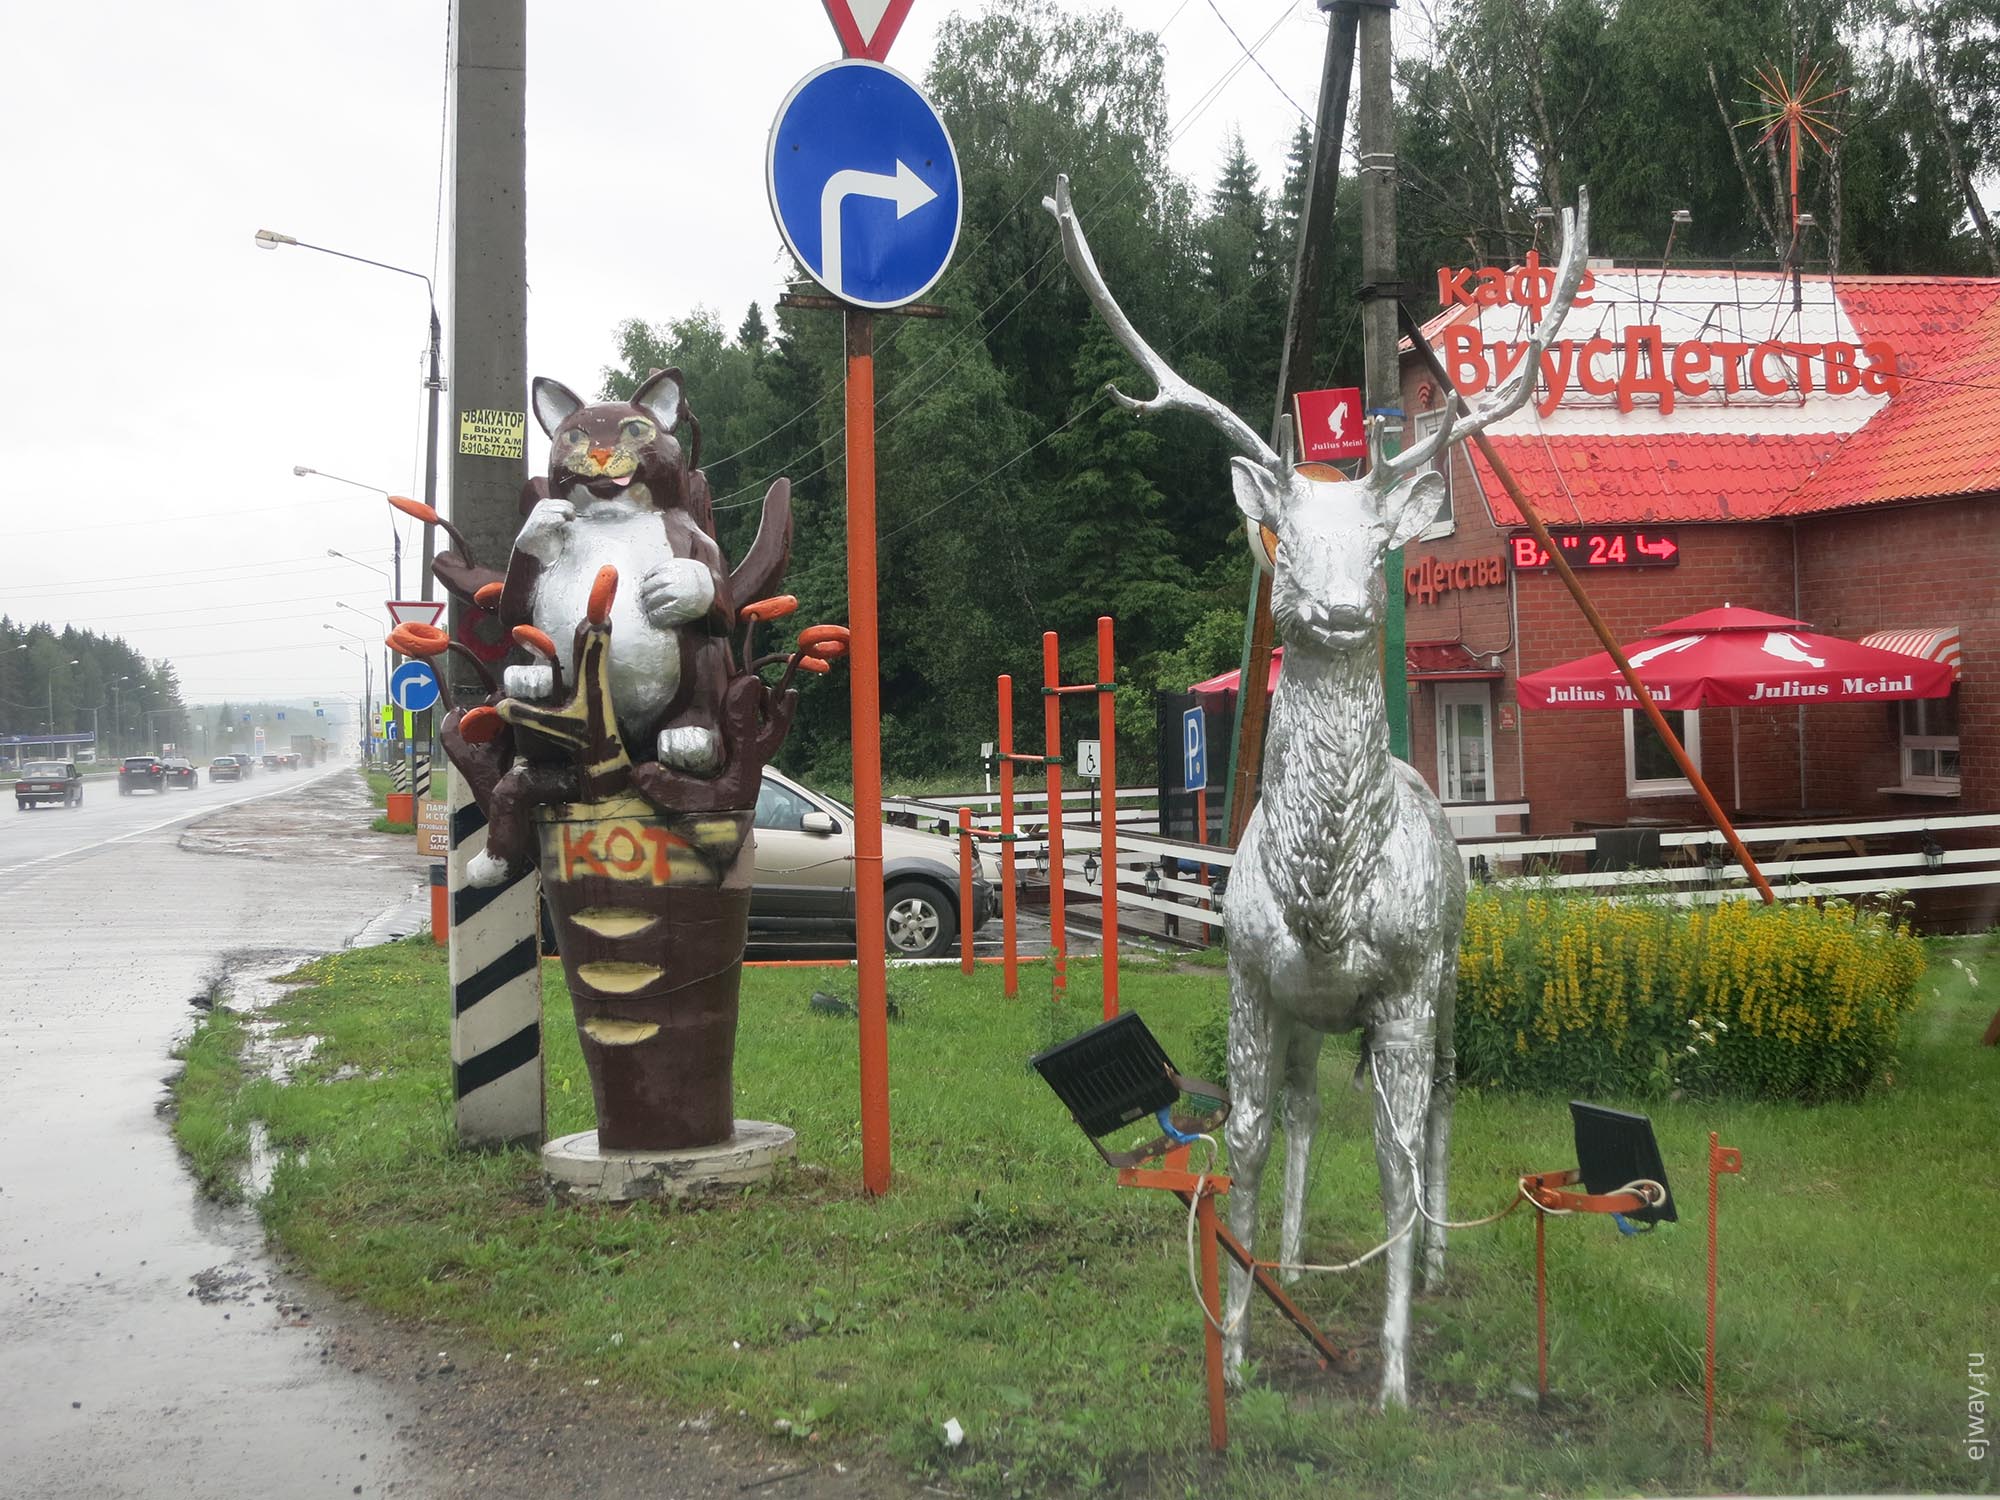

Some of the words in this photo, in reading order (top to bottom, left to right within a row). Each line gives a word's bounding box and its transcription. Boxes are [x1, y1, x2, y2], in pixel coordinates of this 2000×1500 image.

[463, 410, 523, 427] ЭВАКУАТОР
[462, 434, 500, 443] БИТЫХ
[504, 438, 522, 446] А/М
[474, 426, 511, 435] ВЫКУП
[461, 442, 521, 457] 8-910-6-772-772
[1312, 442, 1340, 450] Julius
[1342, 439, 1363, 448] Meinl
[1588, 535, 1627, 564] 24
[1404, 556, 1505, 605] сДетства
[1546, 685, 1606, 704] Julius
[1614, 685, 1671, 701] Minl
[1748, 681, 1829, 701] Julius
[1841, 675, 1913, 695] Meinl
[1188, 718, 1199, 780] P
[562, 824, 689, 882] КОТ
